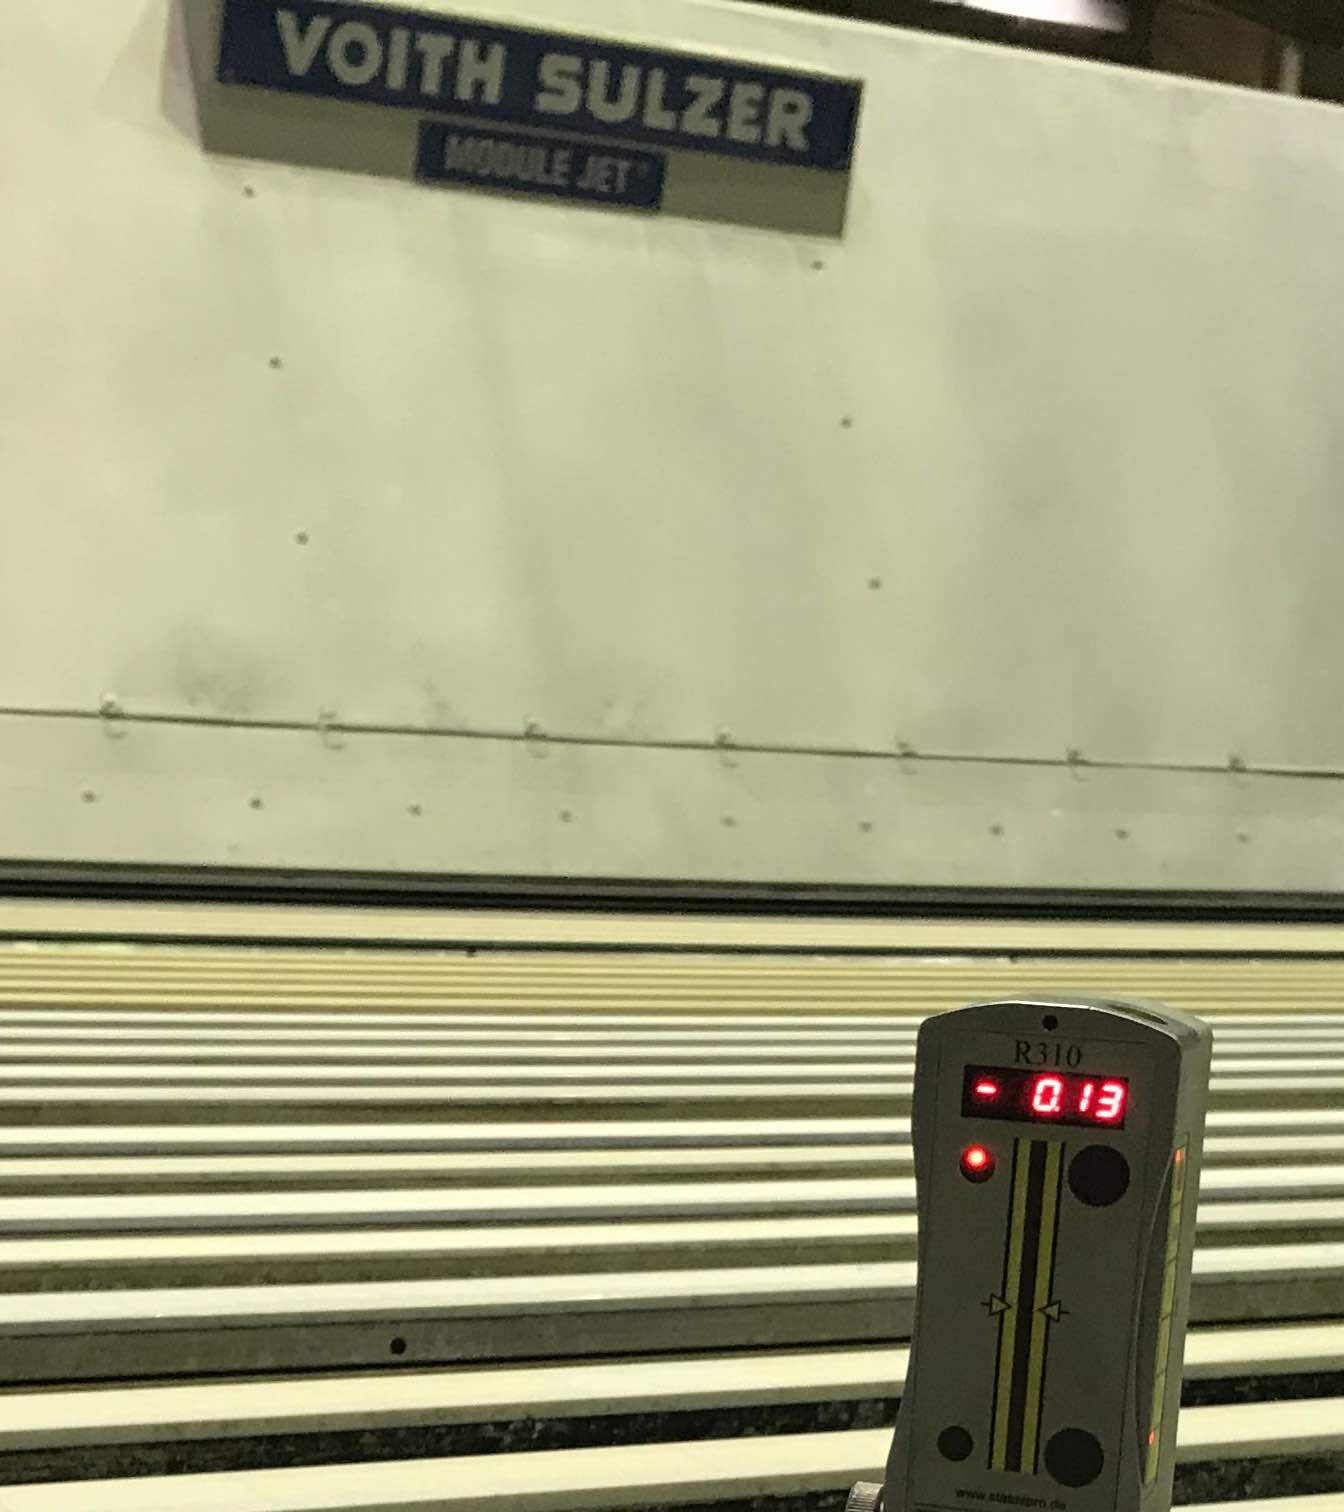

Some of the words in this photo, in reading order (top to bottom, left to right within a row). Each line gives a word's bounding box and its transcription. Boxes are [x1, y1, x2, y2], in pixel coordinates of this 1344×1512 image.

[276, 9, 507, 105] VOITH
[534, 52, 812, 151] SULZER
[444, 135, 570, 186] MODULE
[578, 156, 633, 195] JET
[1014, 1040, 1083, 1068] R310
